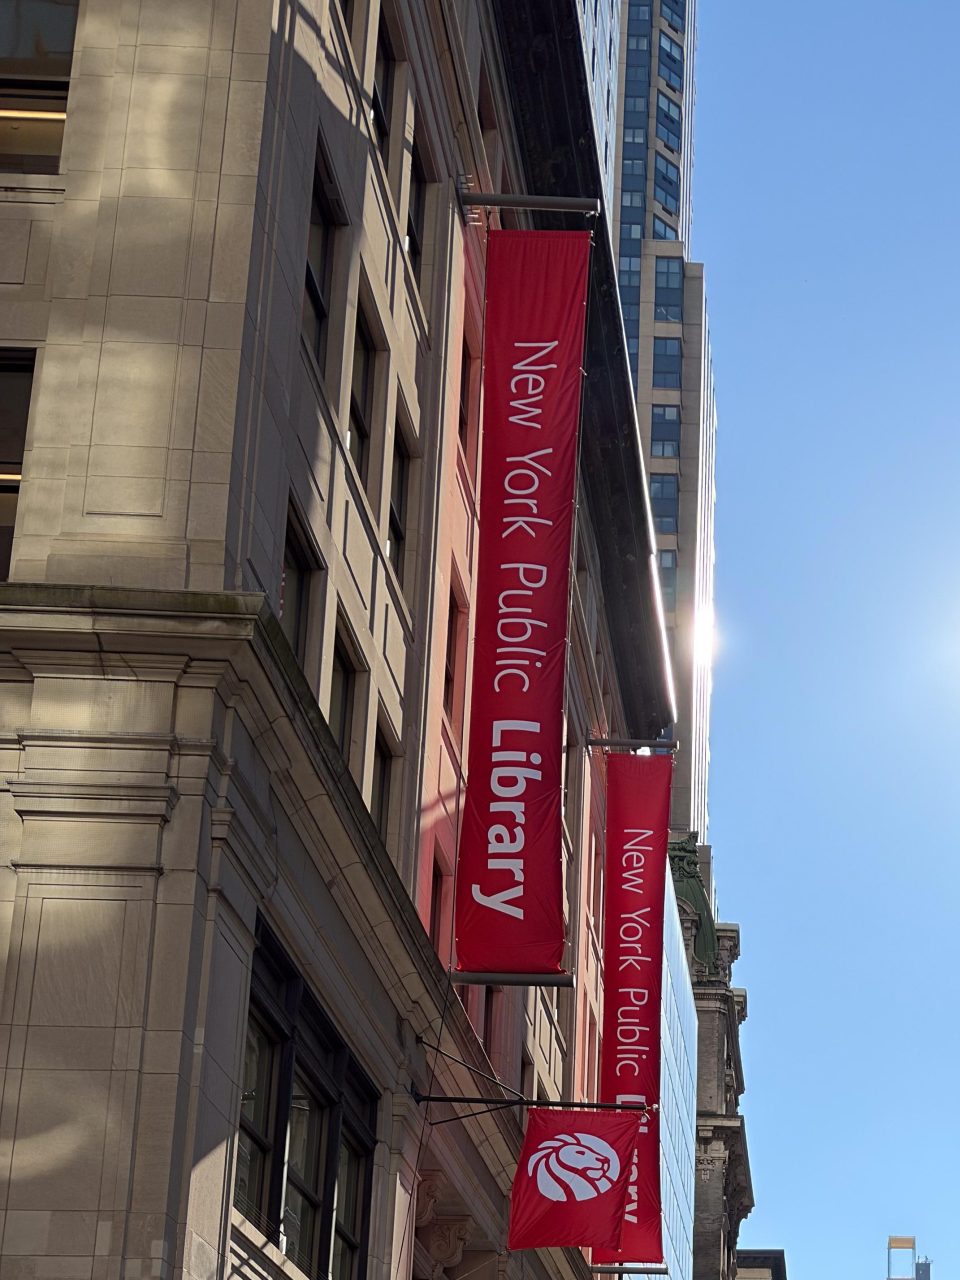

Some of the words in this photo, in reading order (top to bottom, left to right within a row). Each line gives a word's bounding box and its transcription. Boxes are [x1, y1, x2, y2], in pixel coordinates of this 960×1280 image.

[508, 340, 559, 429] New
[502, 447, 553, 539] York
[493, 562, 548, 693] Public
[471, 719, 542, 921] Library
[620, 828, 654, 894] New
[618, 907, 651, 972] York
[615, 988, 650, 1078] Public
